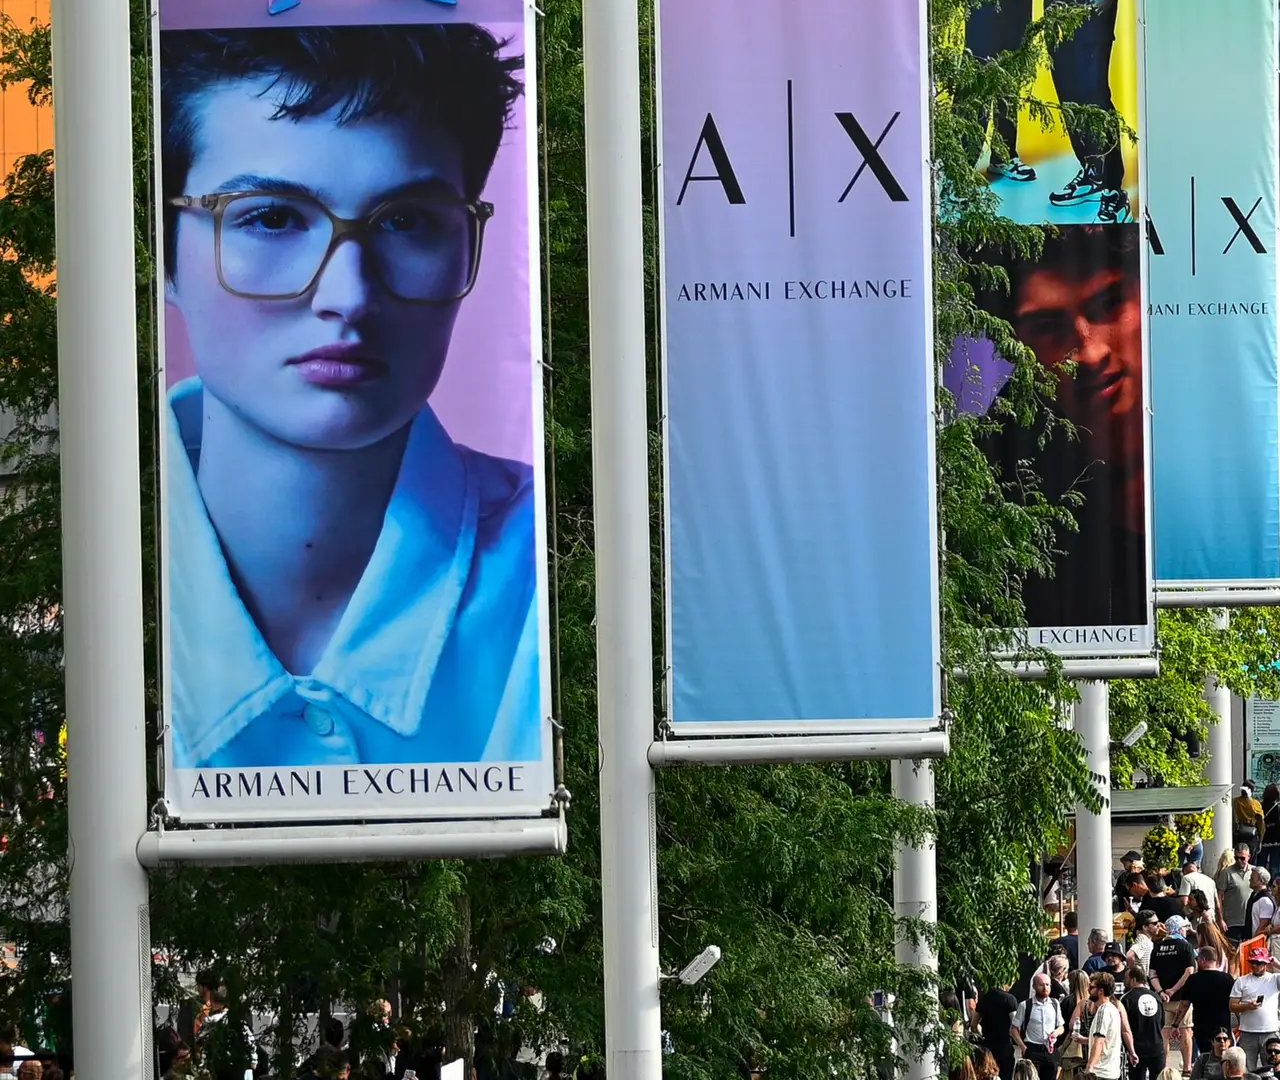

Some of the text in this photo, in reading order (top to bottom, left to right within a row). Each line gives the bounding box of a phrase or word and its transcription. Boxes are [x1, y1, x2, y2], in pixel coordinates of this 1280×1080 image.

[677, 279, 912, 302] ARMANI EXCHANGE
[1188, 302, 1269, 316] EXCHANGE
[1039, 627, 1139, 644] EXCHANGE
[191, 764, 525, 799] ARMANI EXCHANGE
